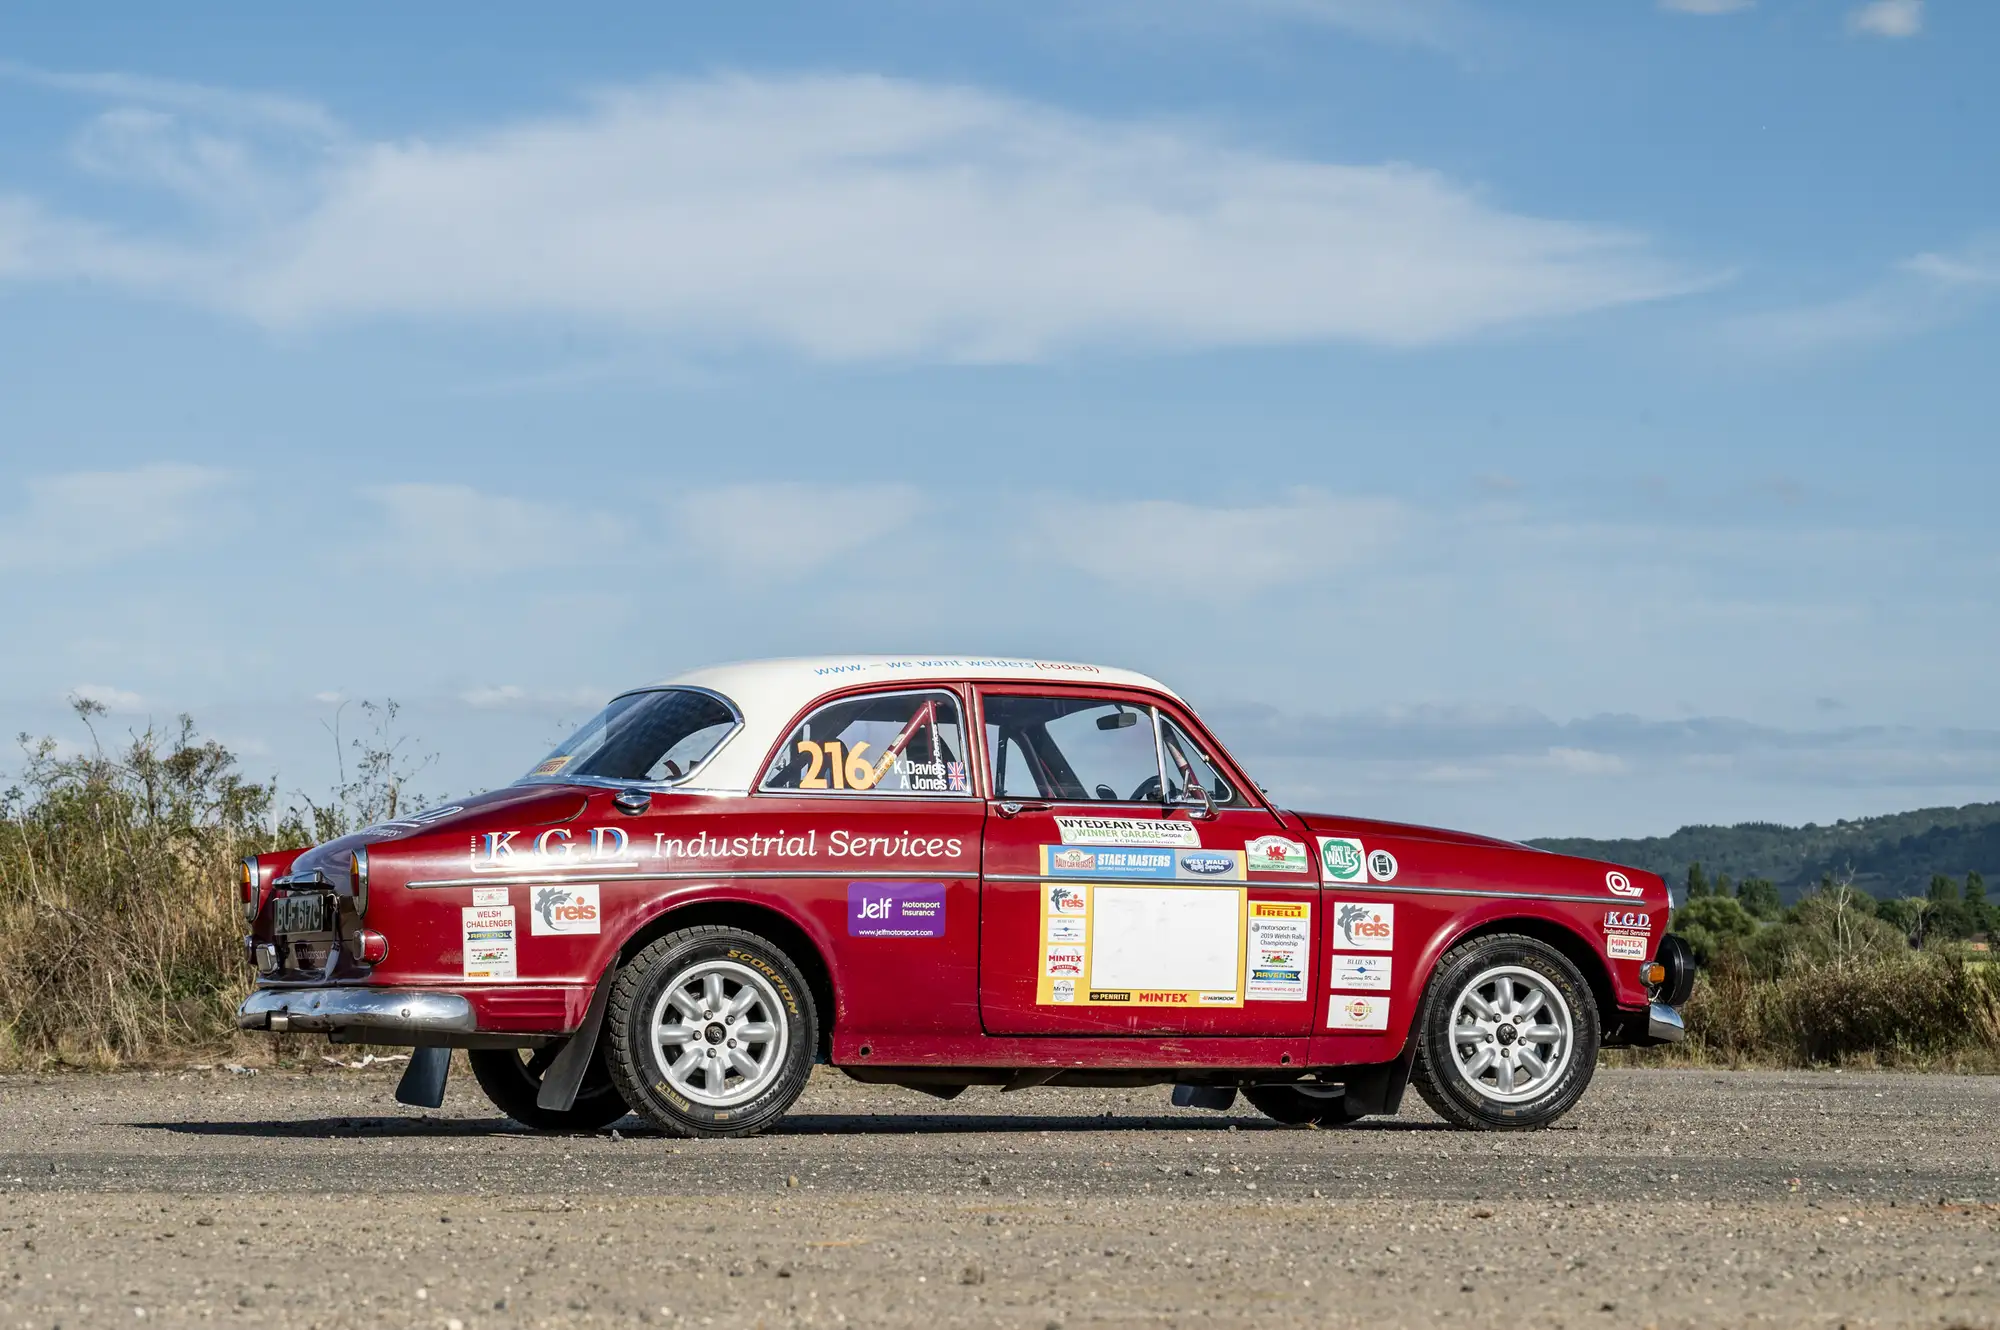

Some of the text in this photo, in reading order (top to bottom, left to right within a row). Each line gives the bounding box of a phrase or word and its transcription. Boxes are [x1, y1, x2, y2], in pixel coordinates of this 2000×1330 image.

[886, 660, 911, 668] we
[917, 659, 963, 668] want
[797, 741, 875, 790] 216
[900, 776, 947, 790] A Jones
[1059, 819, 1192, 832] WYEDEAN STAGES
[1077, 829, 1118, 838] WINNER
[1121, 830, 1161, 839] GARAGE
[652, 830, 818, 858] Industrial
[828, 830, 962, 858] Services
[1098, 853, 1171, 867] STAGE MASTERS
[1325, 850, 1359, 868] WALES
[902, 901, 940, 909] Motorsport
[1061, 894, 1084, 908] reis
[555, 896, 597, 921] reis
[857, 897, 892, 919] Jelf
[902, 909, 935, 917] Insurance
[1256, 904, 1302, 917] PIRELLI
[477, 910, 502, 919] WELSH
[1607, 911, 1652, 927] K.G.D.
[466, 919, 513, 929] CHALLENGER
[1354, 914, 1390, 937] reis
[471, 931, 509, 940] RAVENOL
[858, 929, 934, 937] www.jelfmotorsport.com
[1603, 928, 1651, 937] Industrial Services
[1611, 938, 1643, 948] MINTEX
[1255, 971, 1297, 979] RAVENOL
[727, 949, 799, 1014] SCORPION
[1139, 992, 1188, 1002] MINTEX
[1344, 1005, 1373, 1013] PENRITE
